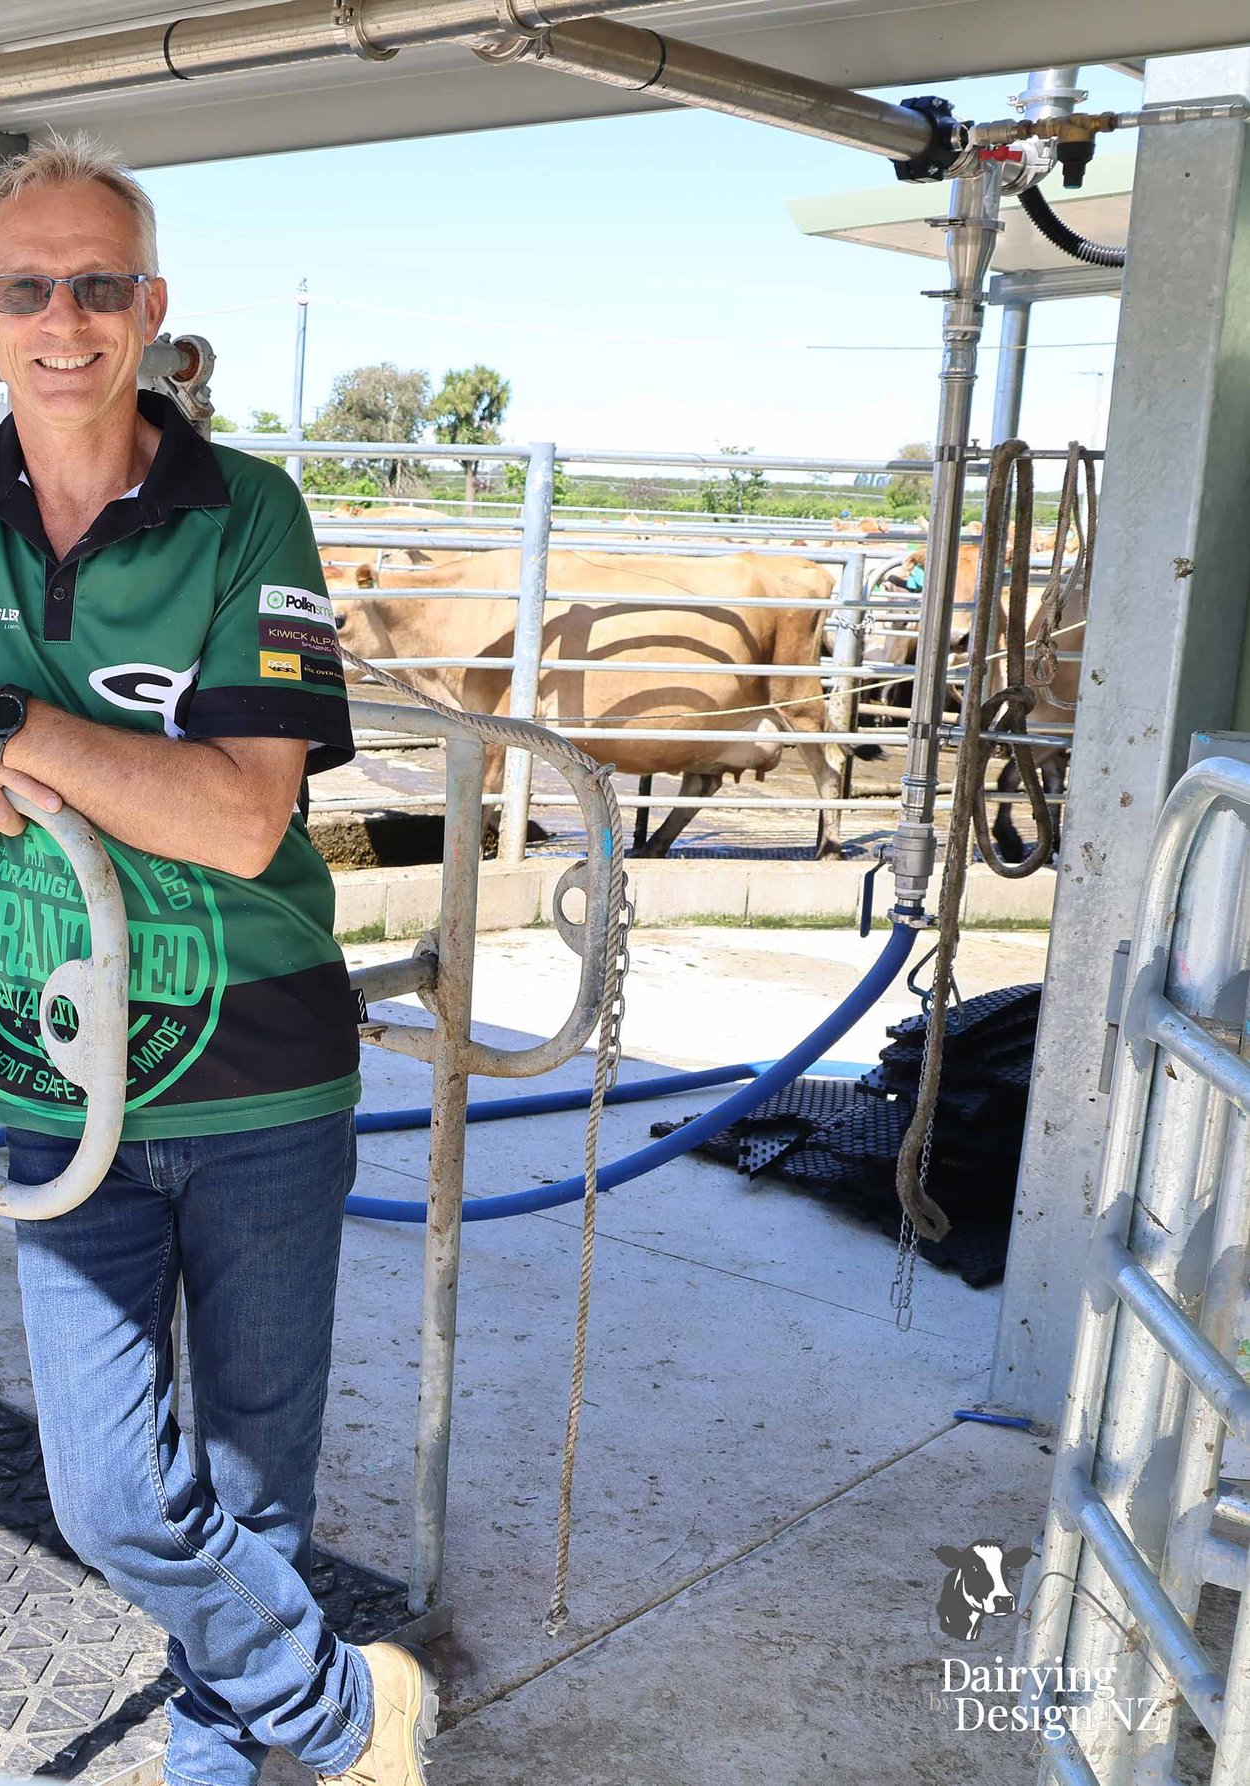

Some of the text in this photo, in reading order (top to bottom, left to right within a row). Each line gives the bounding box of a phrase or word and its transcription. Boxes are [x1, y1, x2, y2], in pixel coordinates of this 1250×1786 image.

[269, 628, 308, 641] KIWICK
[32, 1070, 77, 1100] SAFE
[130, 1016, 186, 1074] MADE
